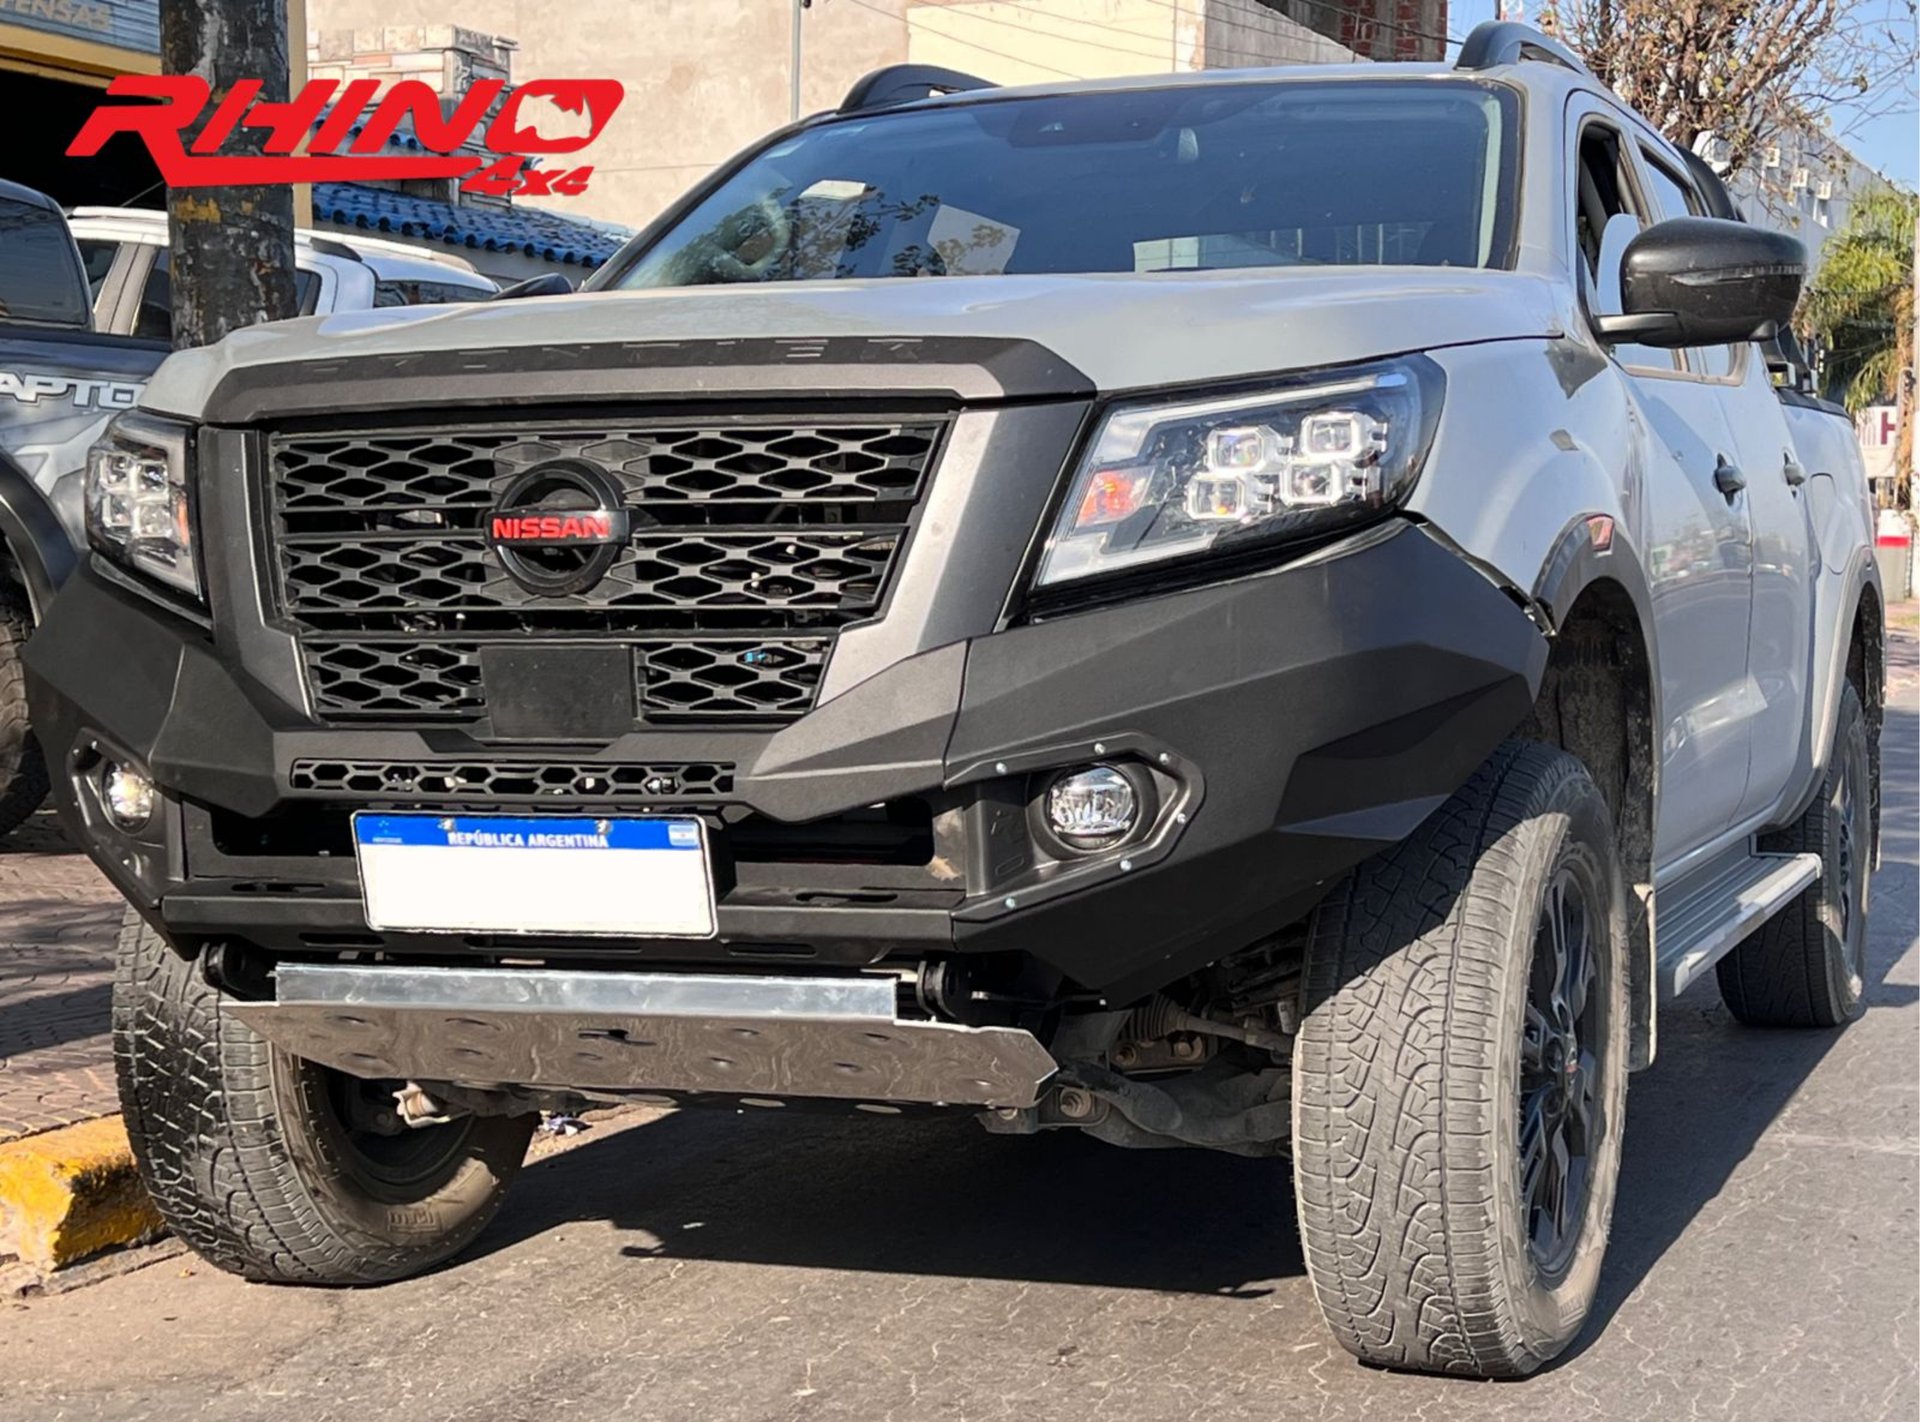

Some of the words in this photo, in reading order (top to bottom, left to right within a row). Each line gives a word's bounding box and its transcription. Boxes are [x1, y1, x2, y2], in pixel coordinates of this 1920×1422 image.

[493, 517, 610, 539] NISSAN
[448, 830, 525, 847] REPÚBLICA
[528, 833, 609, 848] ARGENTINA
